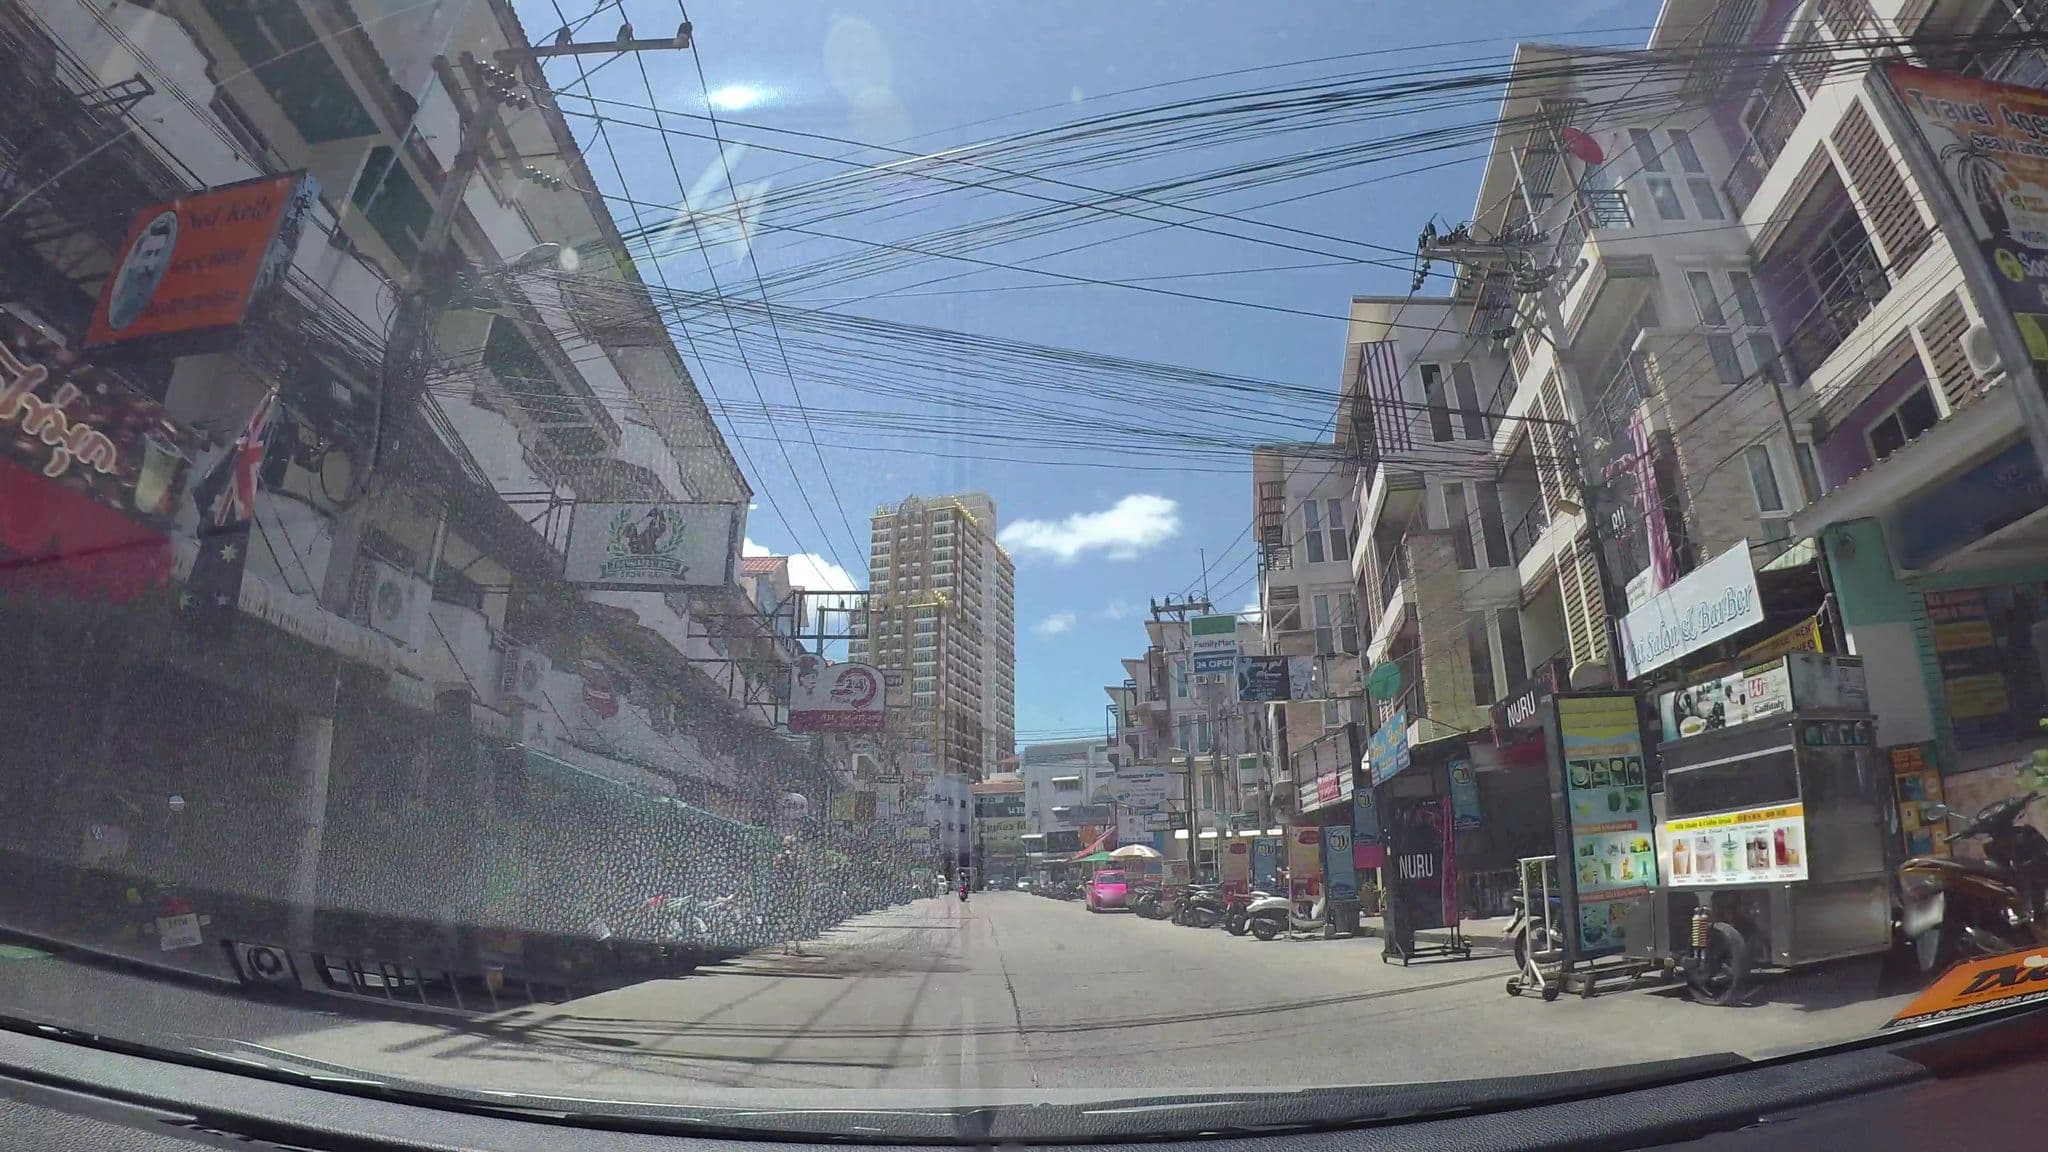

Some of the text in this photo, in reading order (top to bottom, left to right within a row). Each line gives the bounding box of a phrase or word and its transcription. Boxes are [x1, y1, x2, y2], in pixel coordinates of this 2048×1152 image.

[1904, 88, 1994, 126] Travel
[1507, 690, 1536, 728] NURU
[1399, 853, 1434, 880] NURU
